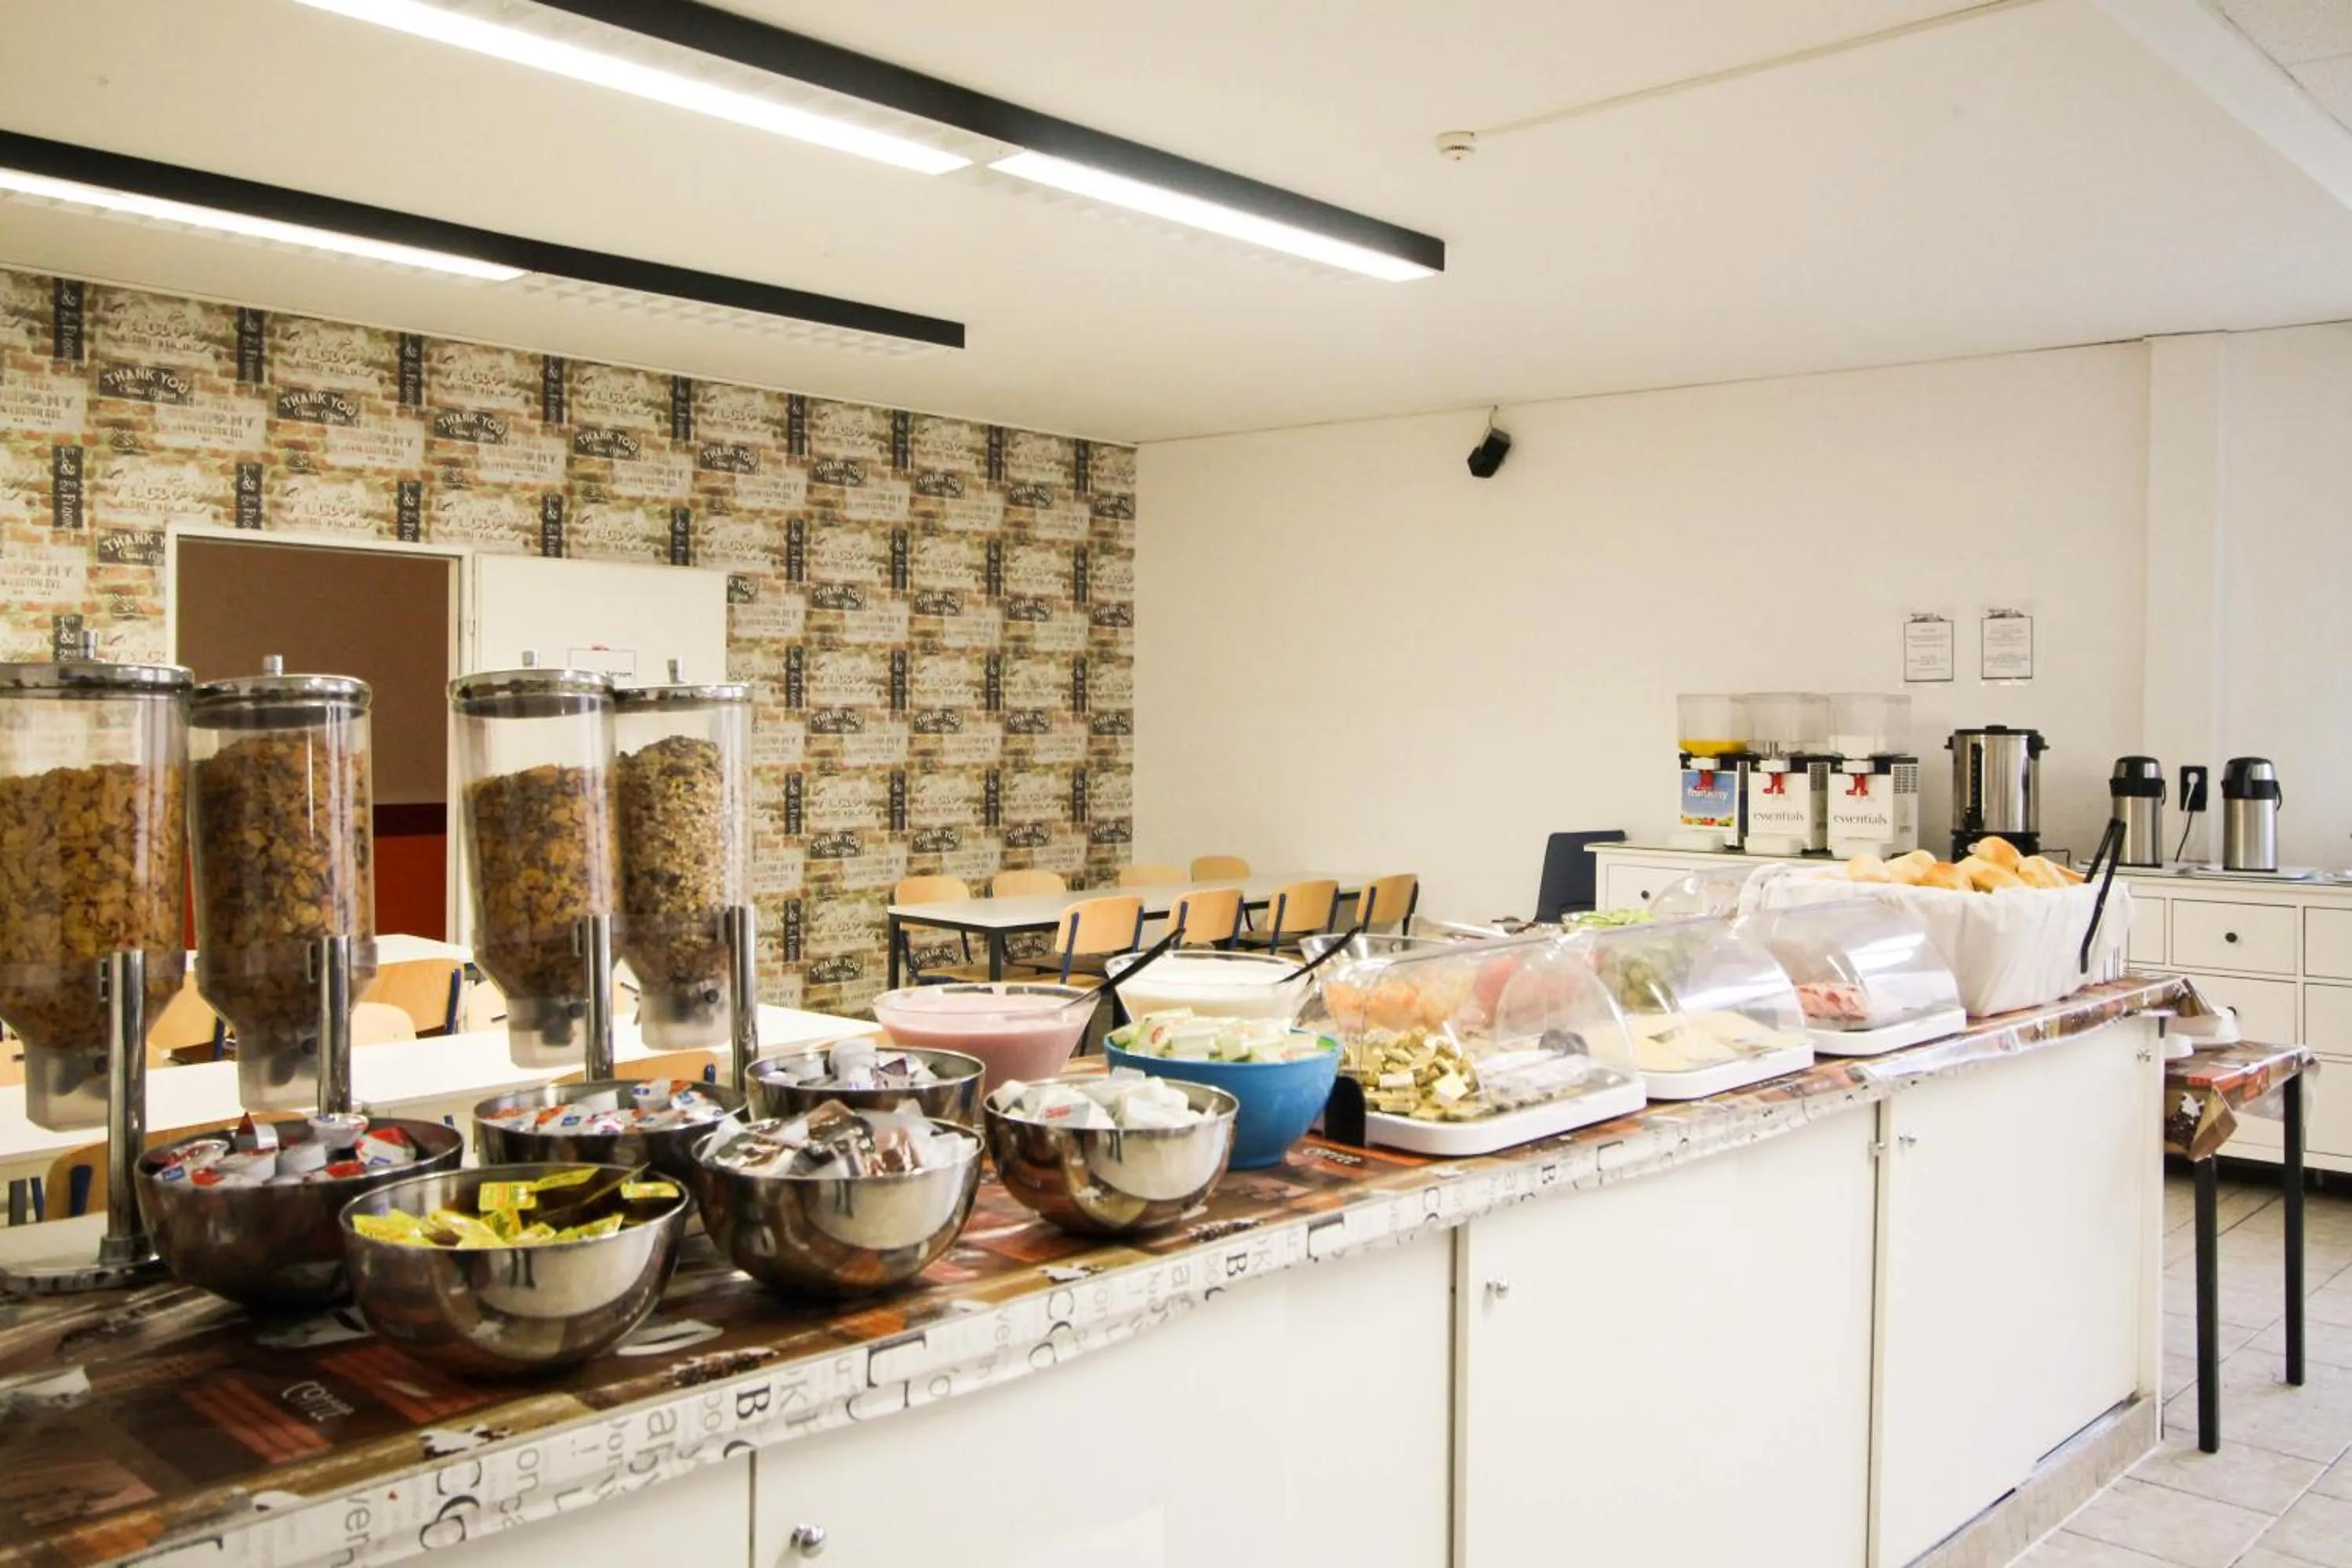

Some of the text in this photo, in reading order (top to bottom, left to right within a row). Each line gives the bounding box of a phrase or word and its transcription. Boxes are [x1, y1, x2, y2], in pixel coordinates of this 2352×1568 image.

[104, 368, 189, 394] THANK YOU
[281, 392, 358, 416] THANK YOU
[439, 413, 506, 434] THANK YOU
[579, 430, 637, 452] THANK YOU
[703, 447, 756, 466] THANK YOU
[103, 532, 154, 552] THANK
[1753, 810, 1805, 822] essentials
[1833, 812, 1888, 825] essentials
[735, 1383, 771, 1420] B
